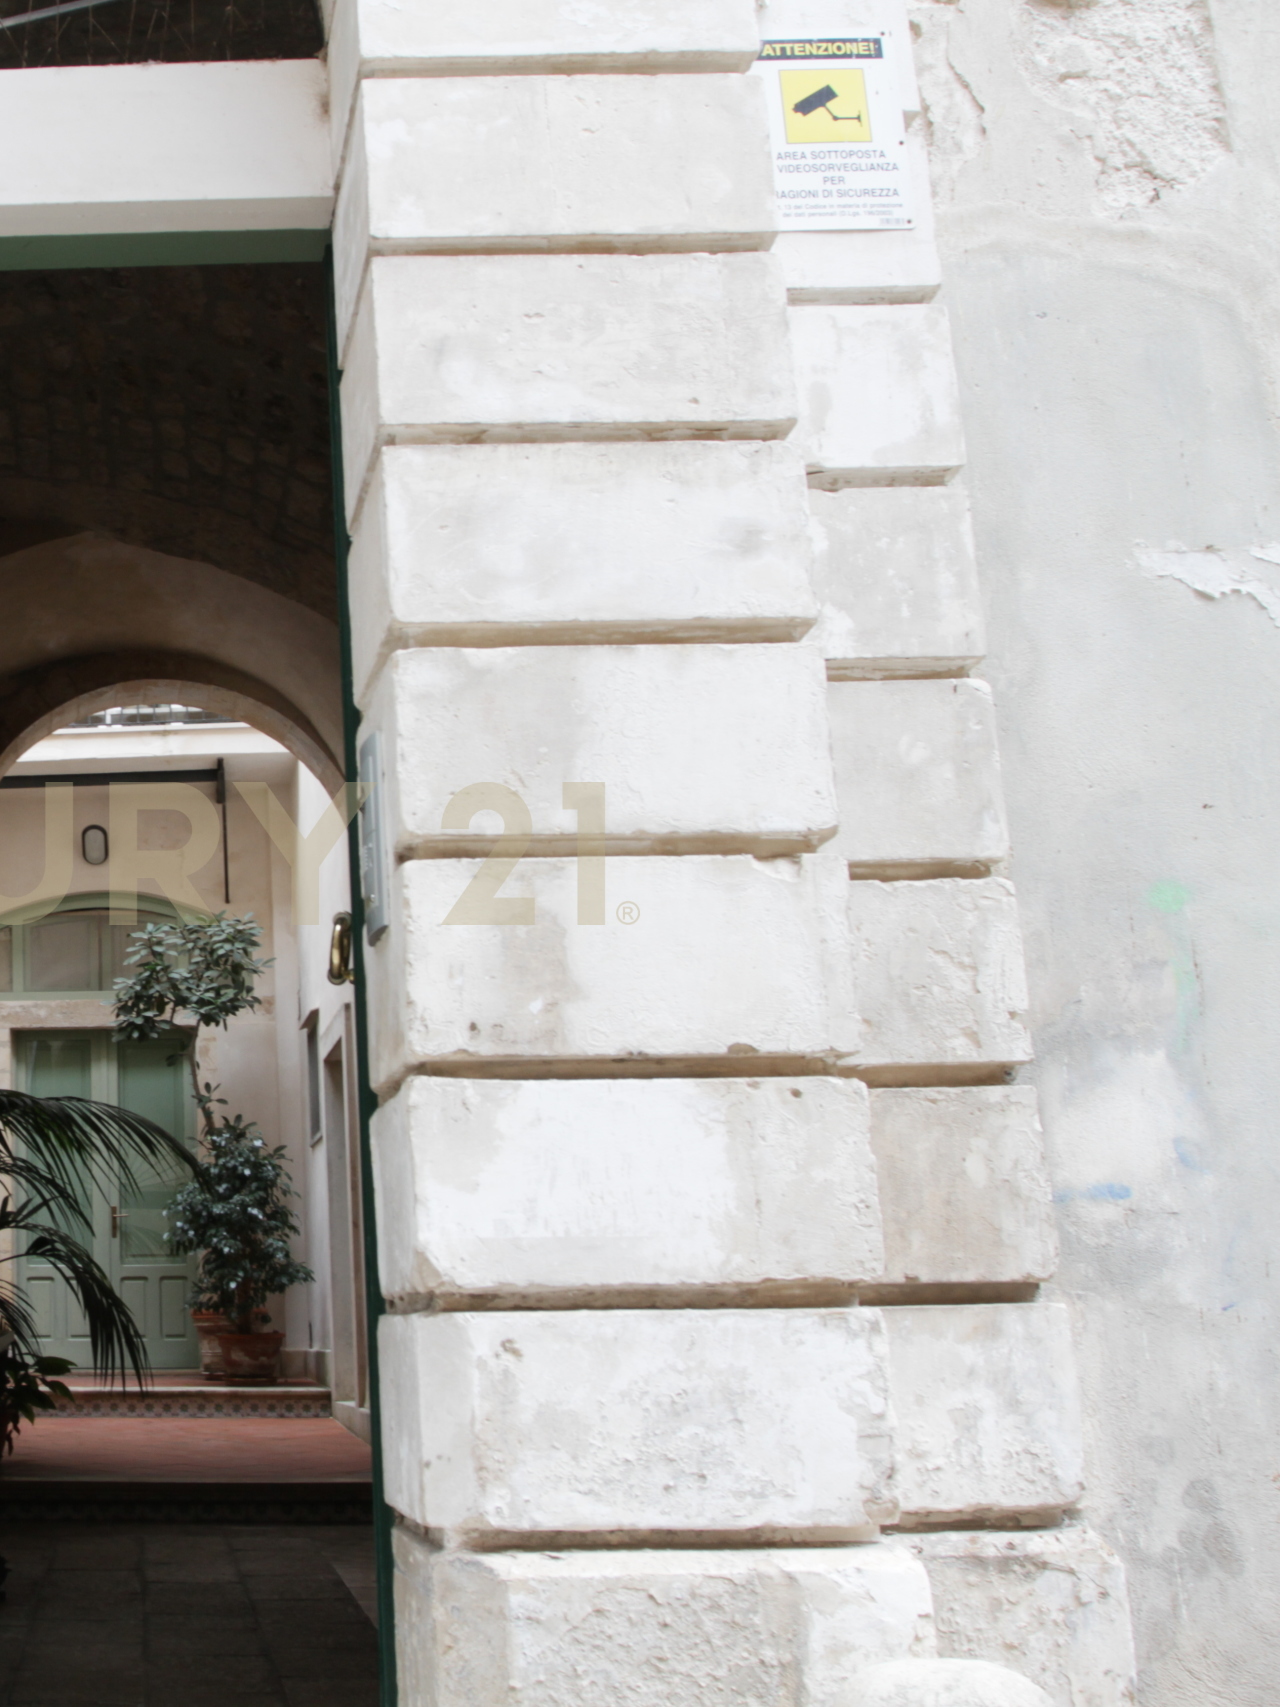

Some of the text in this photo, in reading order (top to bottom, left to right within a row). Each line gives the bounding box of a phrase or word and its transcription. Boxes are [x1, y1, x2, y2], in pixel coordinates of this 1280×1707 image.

[761, 41, 876, 56] ATTENZIONE!
[776, 149, 886, 161] AREA SOTTOPOSTA
[776, 162, 899, 173] VIDEOSORVEGLIANZA
[822, 176, 846, 185] PER
[822, 189, 833, 198] DI
[836, 188, 900, 198] SICUREZZA
